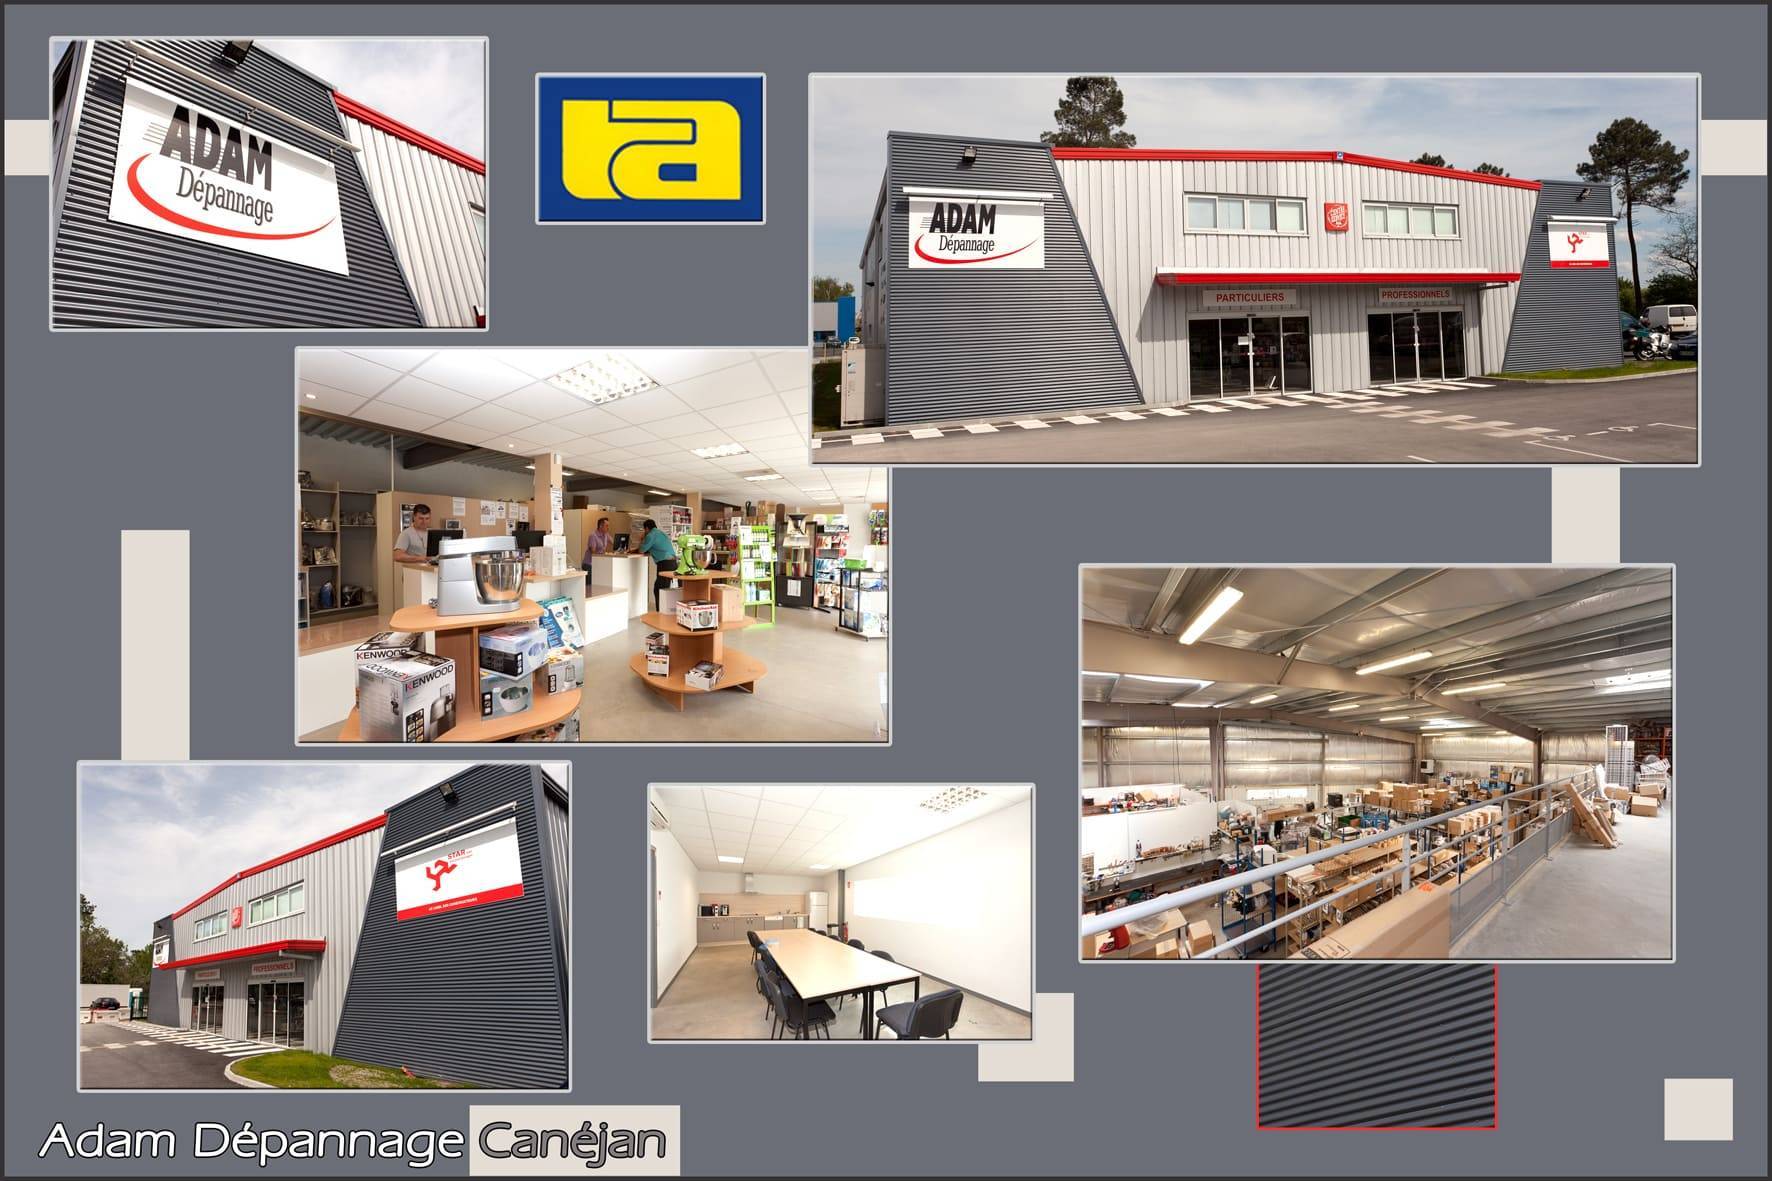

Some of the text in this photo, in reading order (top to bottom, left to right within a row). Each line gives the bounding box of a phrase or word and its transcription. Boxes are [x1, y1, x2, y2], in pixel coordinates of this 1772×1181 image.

[159, 104, 273, 191] ADAM
[176, 166, 274, 226] Dépannage
[929, 202, 997, 234] ADAM
[939, 234, 995, 254] Dépannage
[1216, 292, 1285, 302] PARTICULIERS
[1381, 289, 1450, 299] PROFESSIONNELS
[405, 664, 454, 691] KENWOOD
[447, 849, 466, 860] STAR
